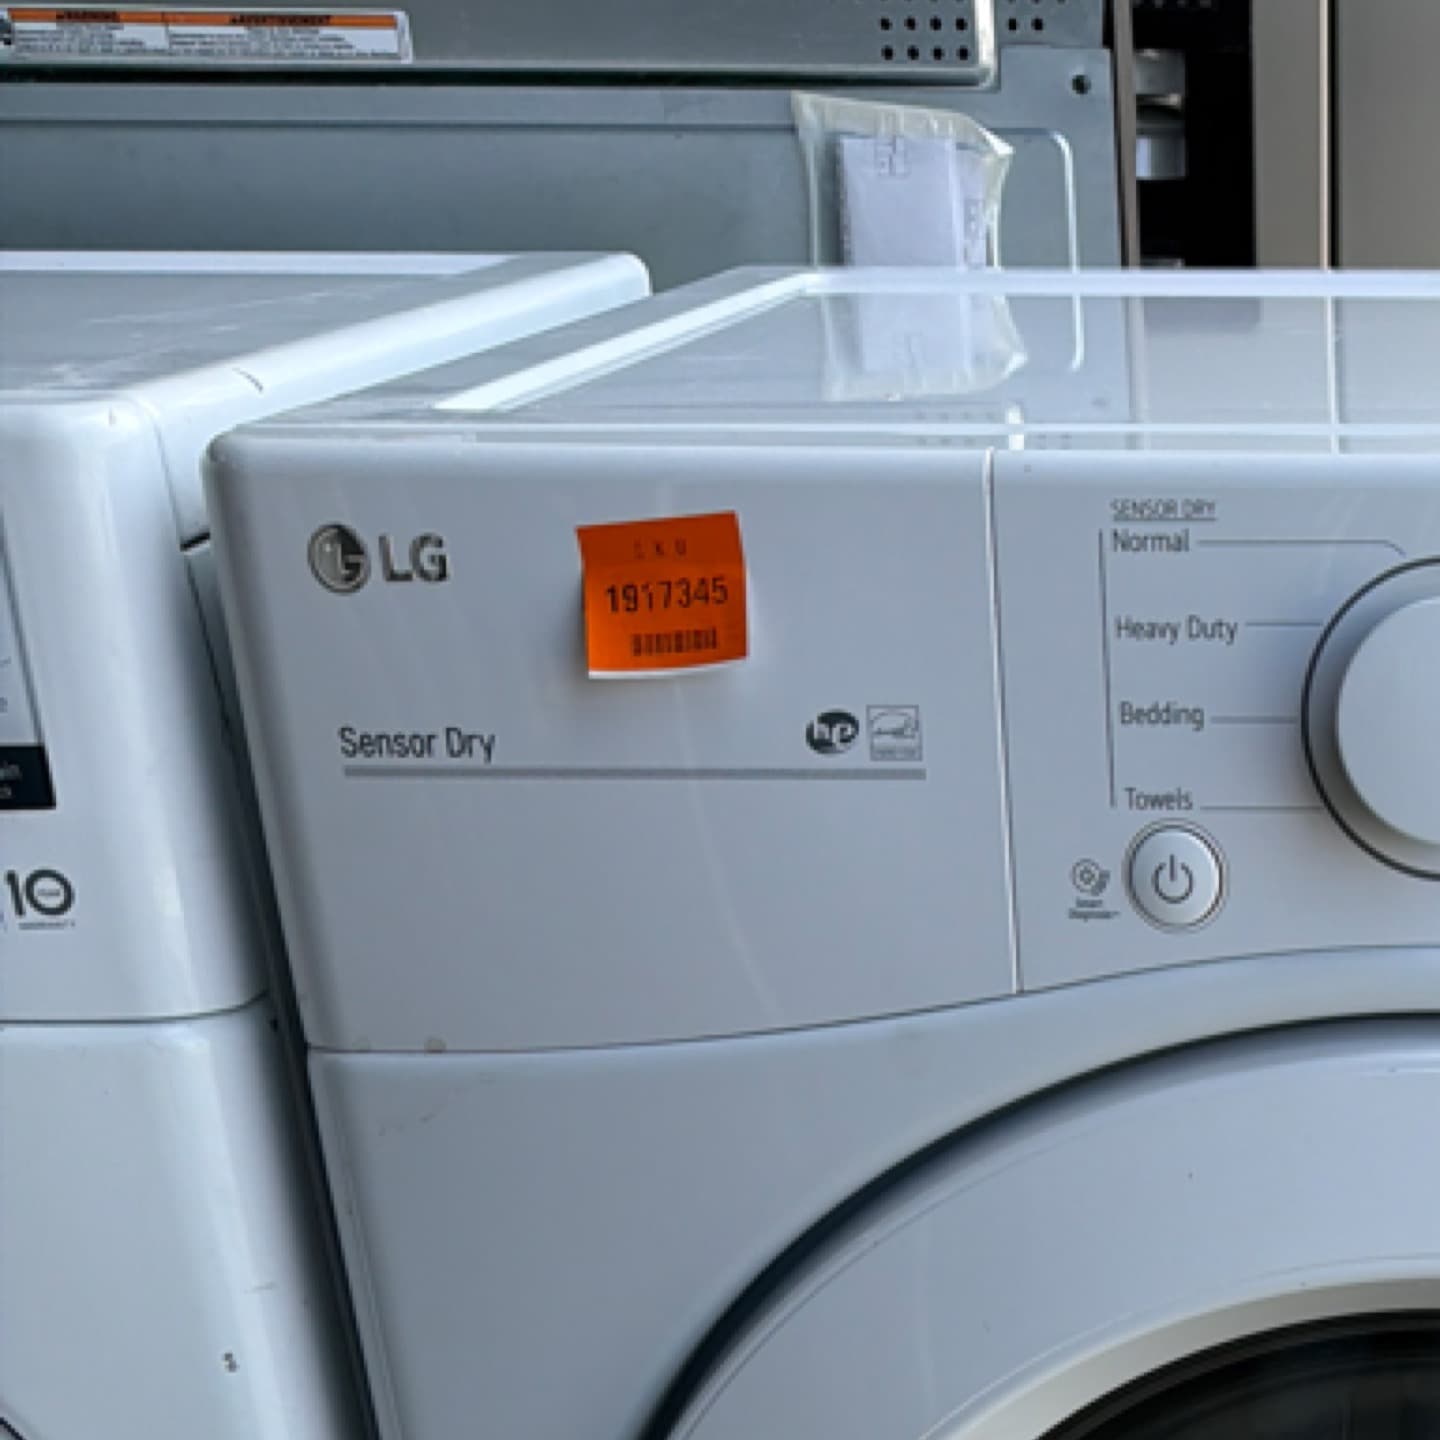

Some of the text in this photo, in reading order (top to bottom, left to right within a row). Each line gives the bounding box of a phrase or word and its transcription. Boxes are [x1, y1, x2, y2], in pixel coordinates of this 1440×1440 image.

[1110, 499, 1217, 517] SENSOR DRY
[1112, 529, 1191, 552] Normal
[378, 532, 449, 583] LG
[606, 574, 729, 613] 1917345
[1115, 615, 1238, 644] Heavy Duty
[1119, 702, 1205, 731] Bedding
[339, 726, 496, 764] Sensor Dry
[1124, 786, 1193, 811] Towels
[5, 868, 75, 918] 10
